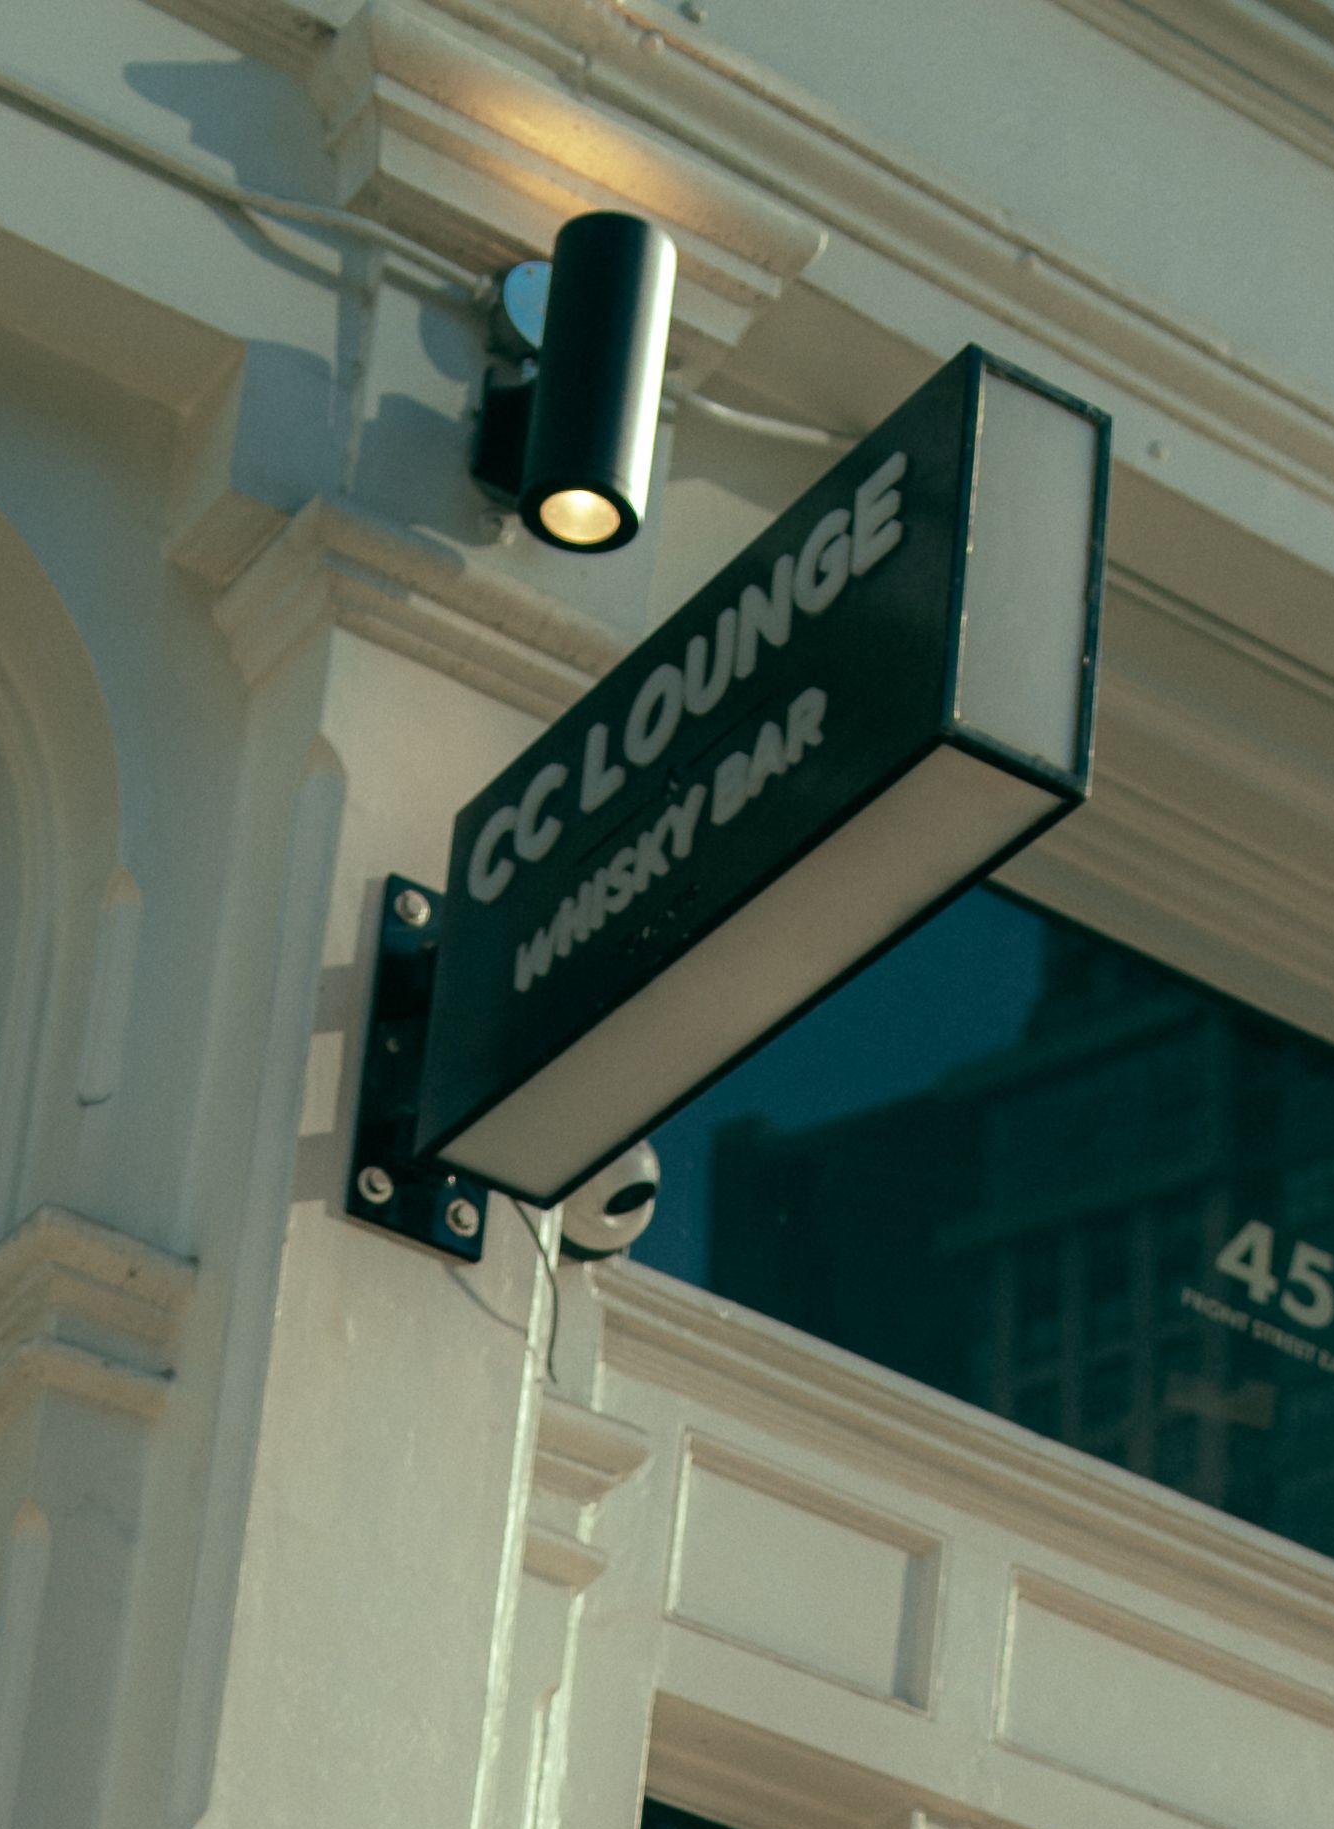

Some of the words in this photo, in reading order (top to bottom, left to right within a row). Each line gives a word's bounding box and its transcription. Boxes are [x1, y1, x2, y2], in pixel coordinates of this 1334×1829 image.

[468, 764, 568, 904] CC
[580, 451, 910, 814] LOUNGE
[514, 785, 706, 992] WHISKY
[711, 686, 828, 825] BAR
